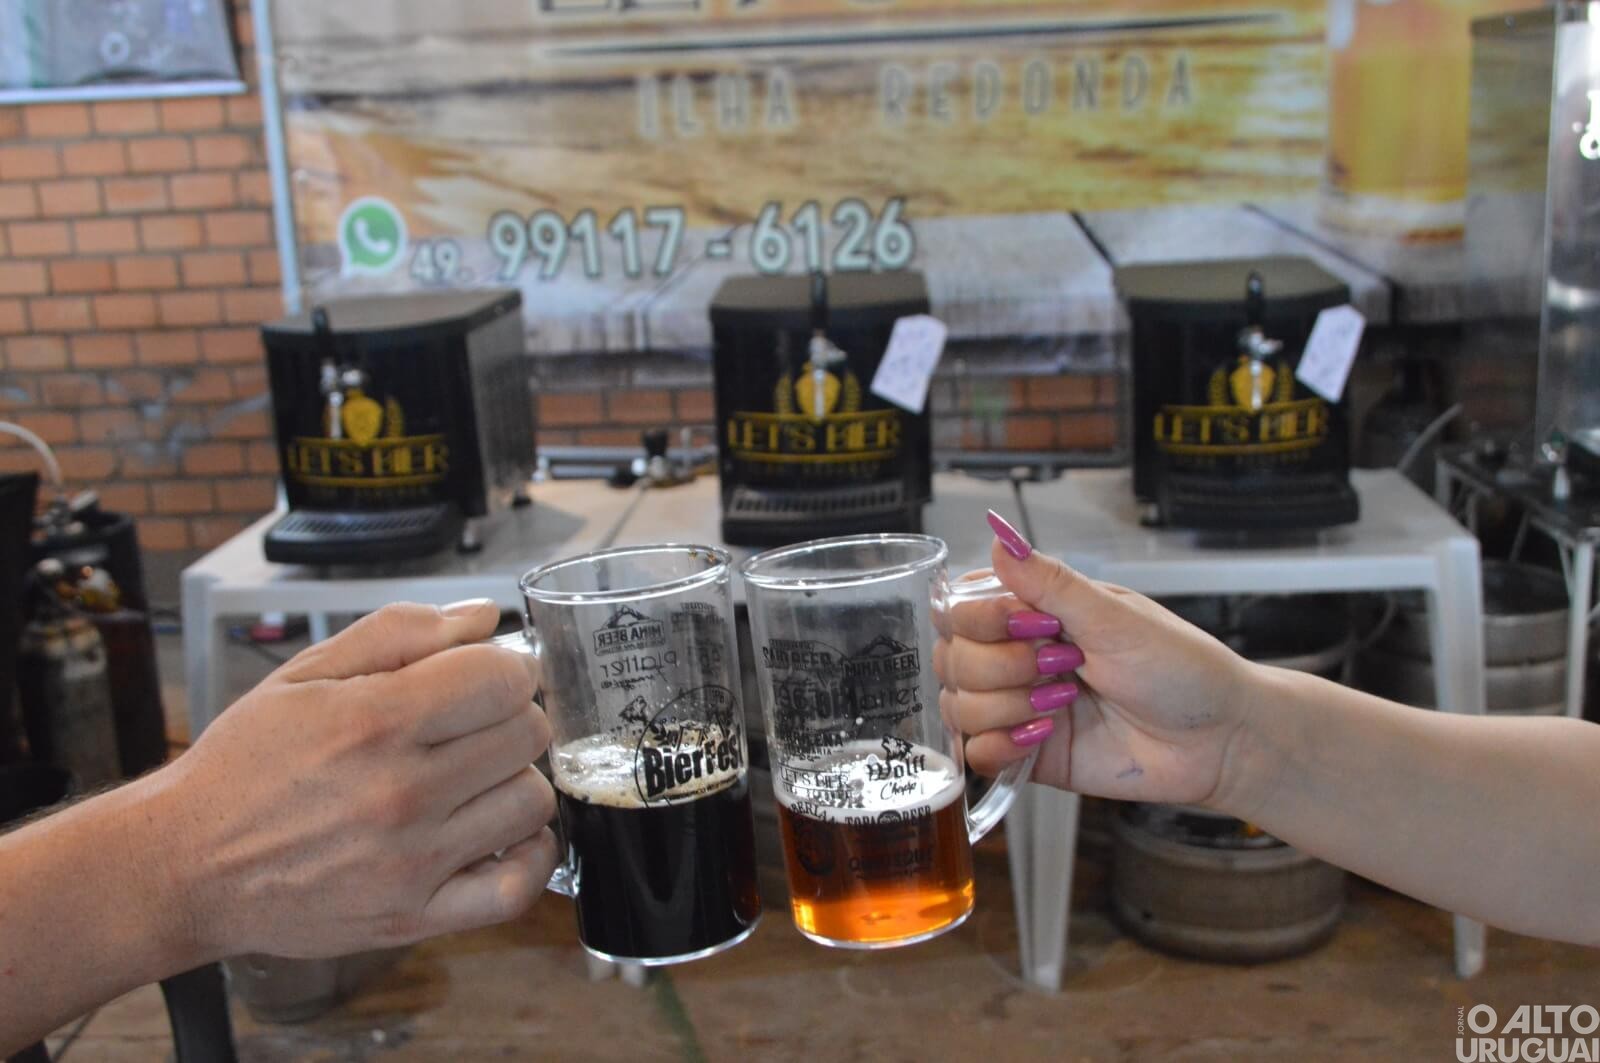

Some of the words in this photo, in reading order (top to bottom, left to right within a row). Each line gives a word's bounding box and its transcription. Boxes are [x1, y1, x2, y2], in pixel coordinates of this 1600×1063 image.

[637, 66, 797, 137] ILHA
[879, 52, 1198, 127] REDONDA
[488, 208, 687, 281] 99117
[751, 199, 916, 276] 6126
